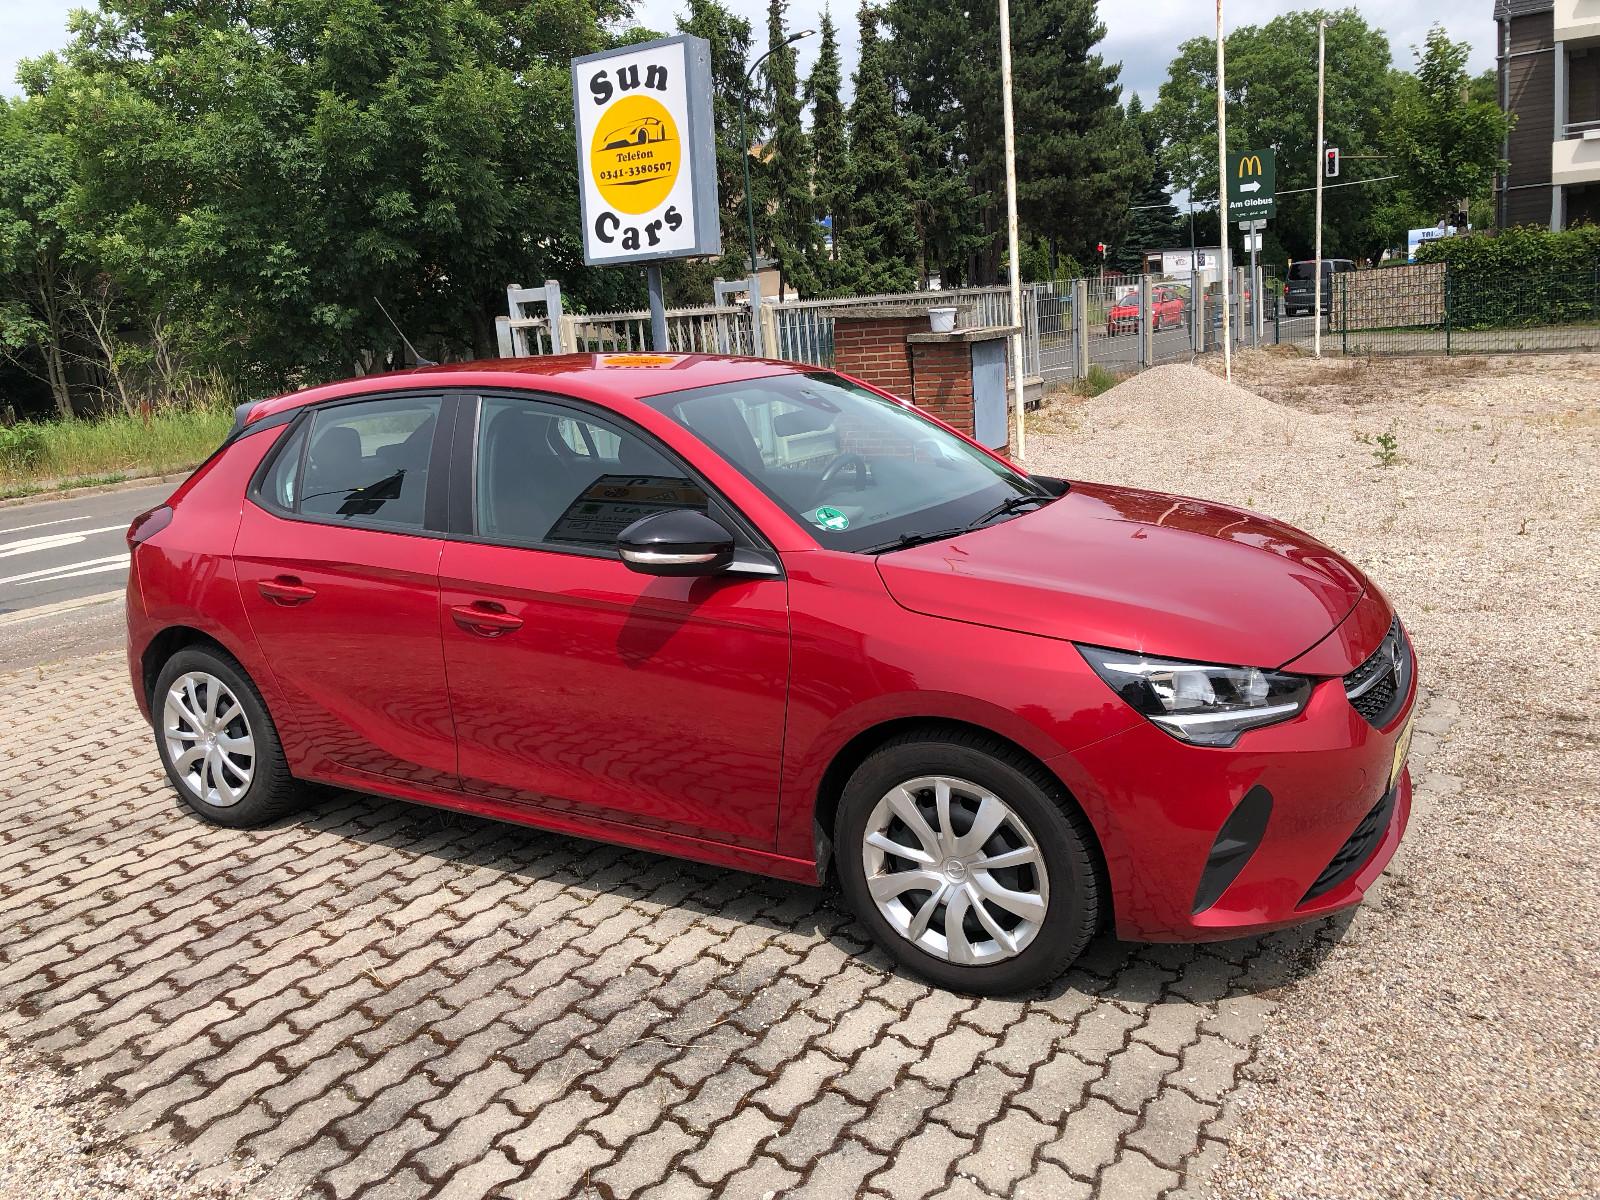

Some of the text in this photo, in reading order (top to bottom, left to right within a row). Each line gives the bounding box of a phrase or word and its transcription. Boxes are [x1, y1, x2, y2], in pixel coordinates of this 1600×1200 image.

[589, 64, 668, 106] Sun
[616, 150, 653, 163] Telefon
[599, 162, 672, 180] 0341-3380507
[1229, 197, 1272, 209] Am Globus
[594, 205, 683, 251] Cars
